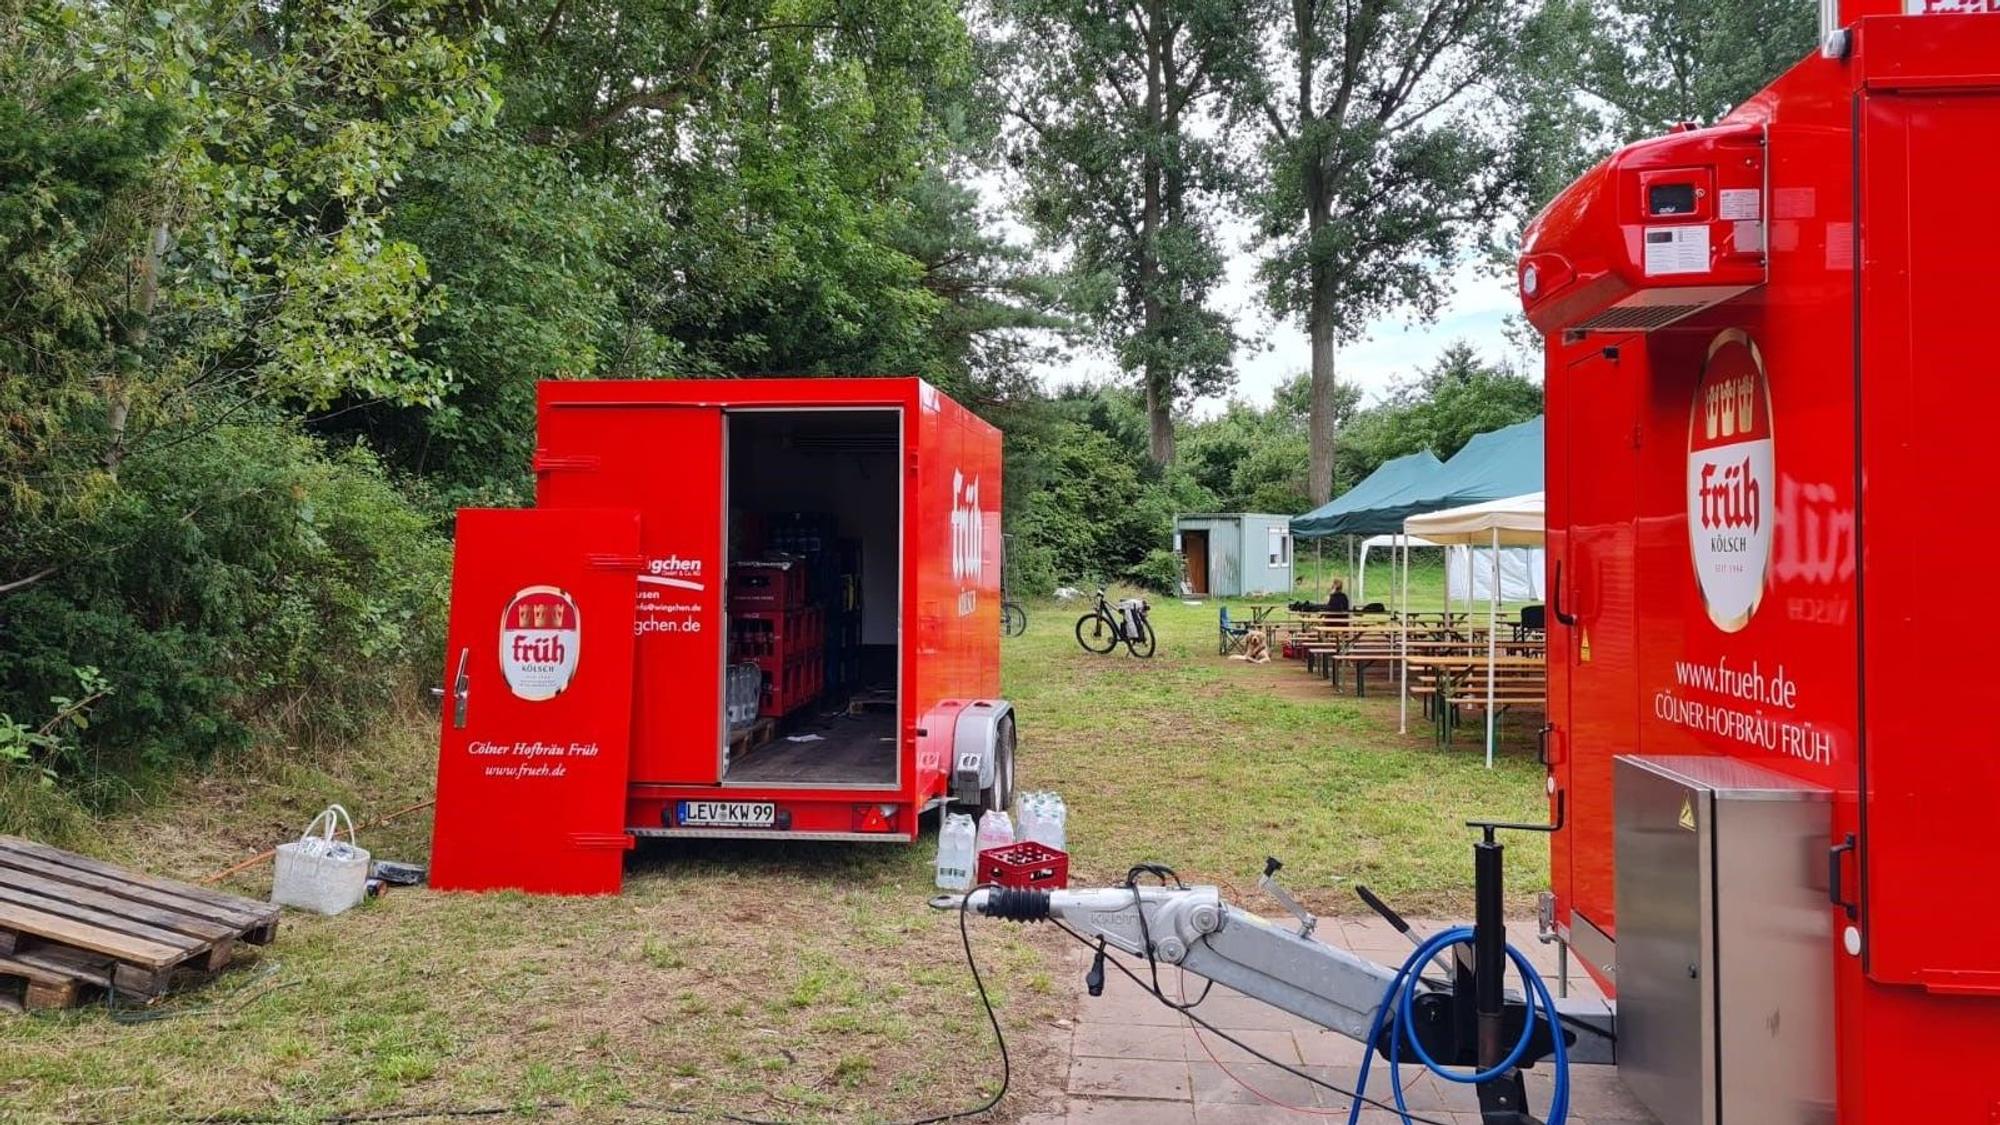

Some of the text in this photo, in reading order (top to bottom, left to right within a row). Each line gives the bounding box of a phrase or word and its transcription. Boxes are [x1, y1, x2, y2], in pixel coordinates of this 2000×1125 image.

[1699, 456, 1760, 536] früh
[951, 467, 982, 588] früh
[1711, 534, 1747, 553] KÖLSCH
[512, 635, 565, 665] früh
[1676, 656, 1797, 709] www.frueh.de
[1655, 689, 1831, 766] CÖLNER HOFBRÄU FRÜH
[468, 741, 599, 759] Cölner Hofbräu Früh
[485, 763, 566, 779] www.frueh.de
[687, 803, 774, 821] LEV KW 99
